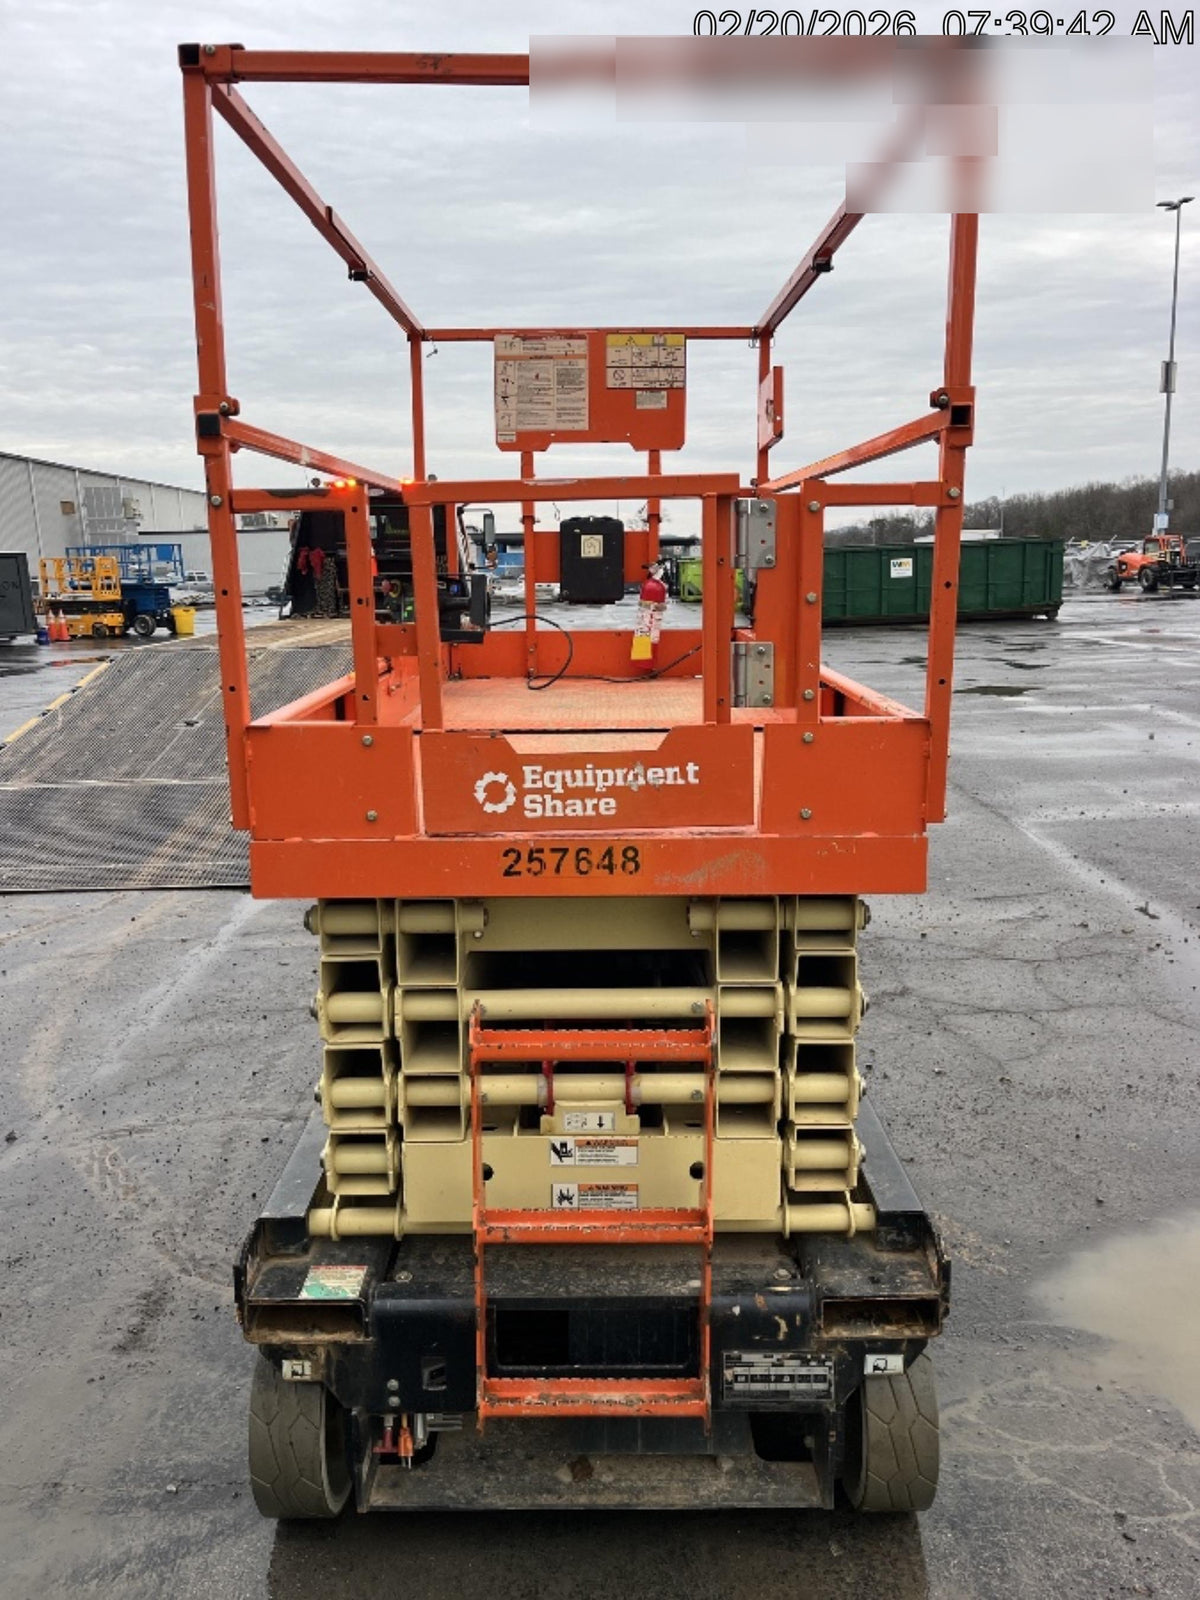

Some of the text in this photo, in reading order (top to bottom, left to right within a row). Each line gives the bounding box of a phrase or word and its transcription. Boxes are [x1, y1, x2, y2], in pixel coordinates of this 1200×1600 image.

[522, 761, 700, 793] Equipment
[523, 795, 617, 818] Share
[502, 846, 641, 877] 257648
